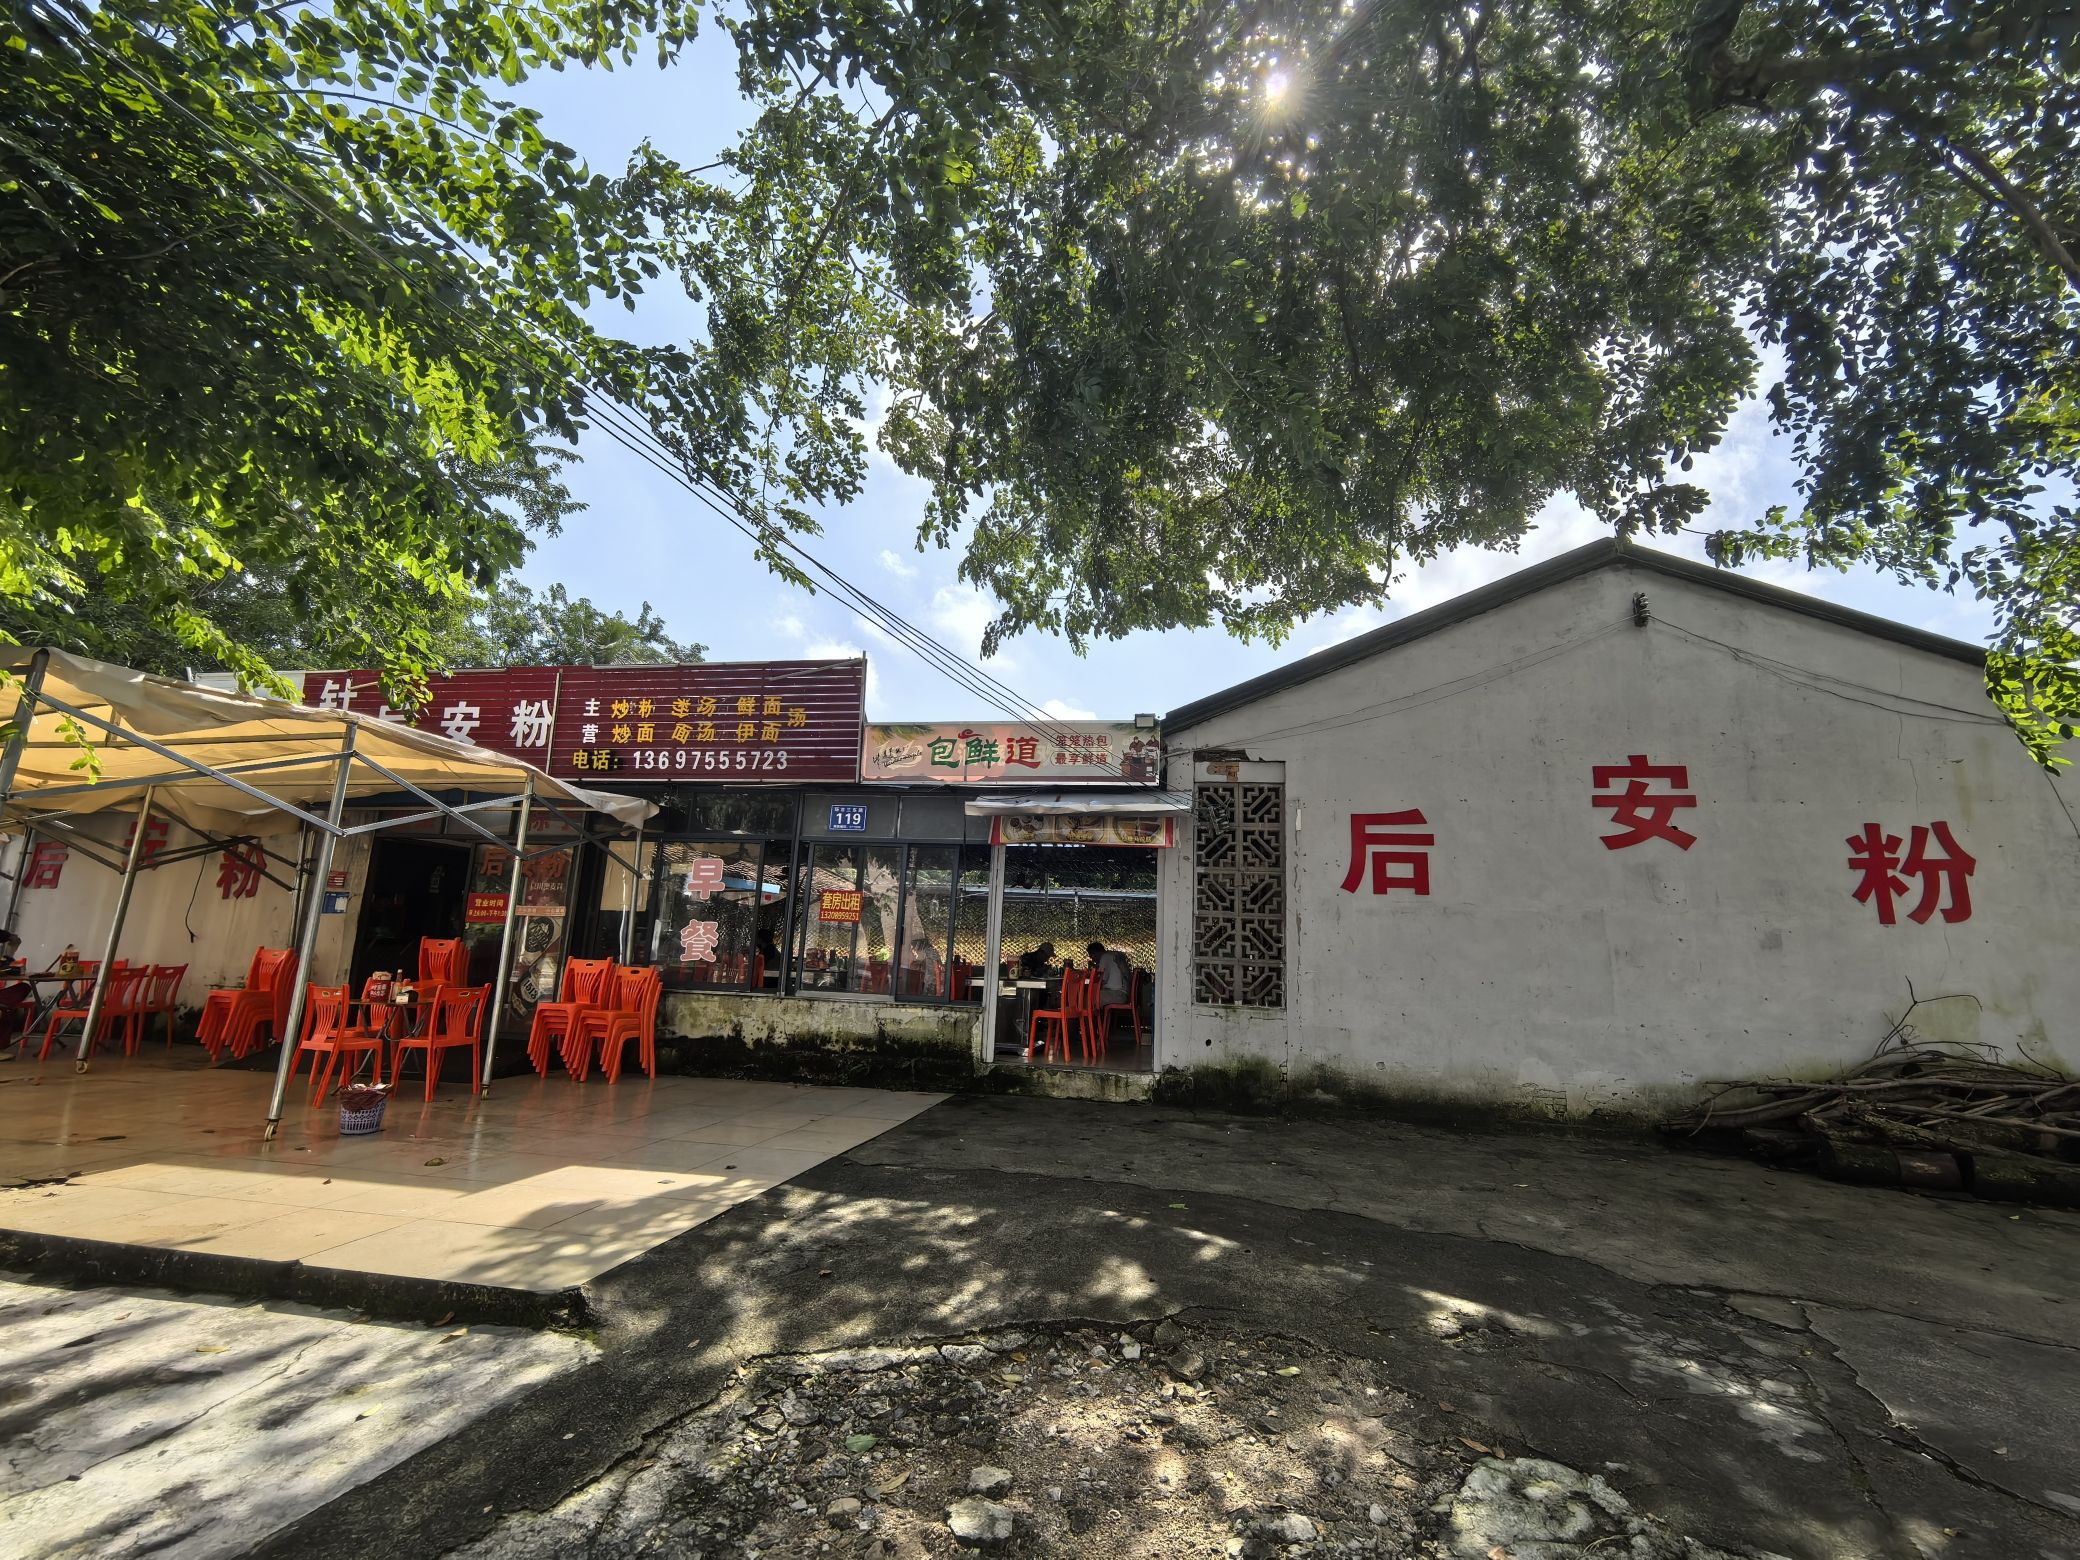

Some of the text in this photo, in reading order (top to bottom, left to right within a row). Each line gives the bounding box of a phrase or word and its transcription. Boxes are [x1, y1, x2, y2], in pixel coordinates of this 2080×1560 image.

[736, 696, 783, 717] 鲜面
[611, 723, 656, 744] 炒面
[736, 722, 783, 743] 伊面
[633, 750, 789, 770] 13697555723
[927, 736, 1041, 769] 包鲜道
[836, 813, 861, 825] 119
[1340, 754, 1977, 925] 后安粉
[475, 899, 504, 908] 营业时间
[680, 858, 726, 962] 早餐
[822, 892, 861, 910] 套房出租
